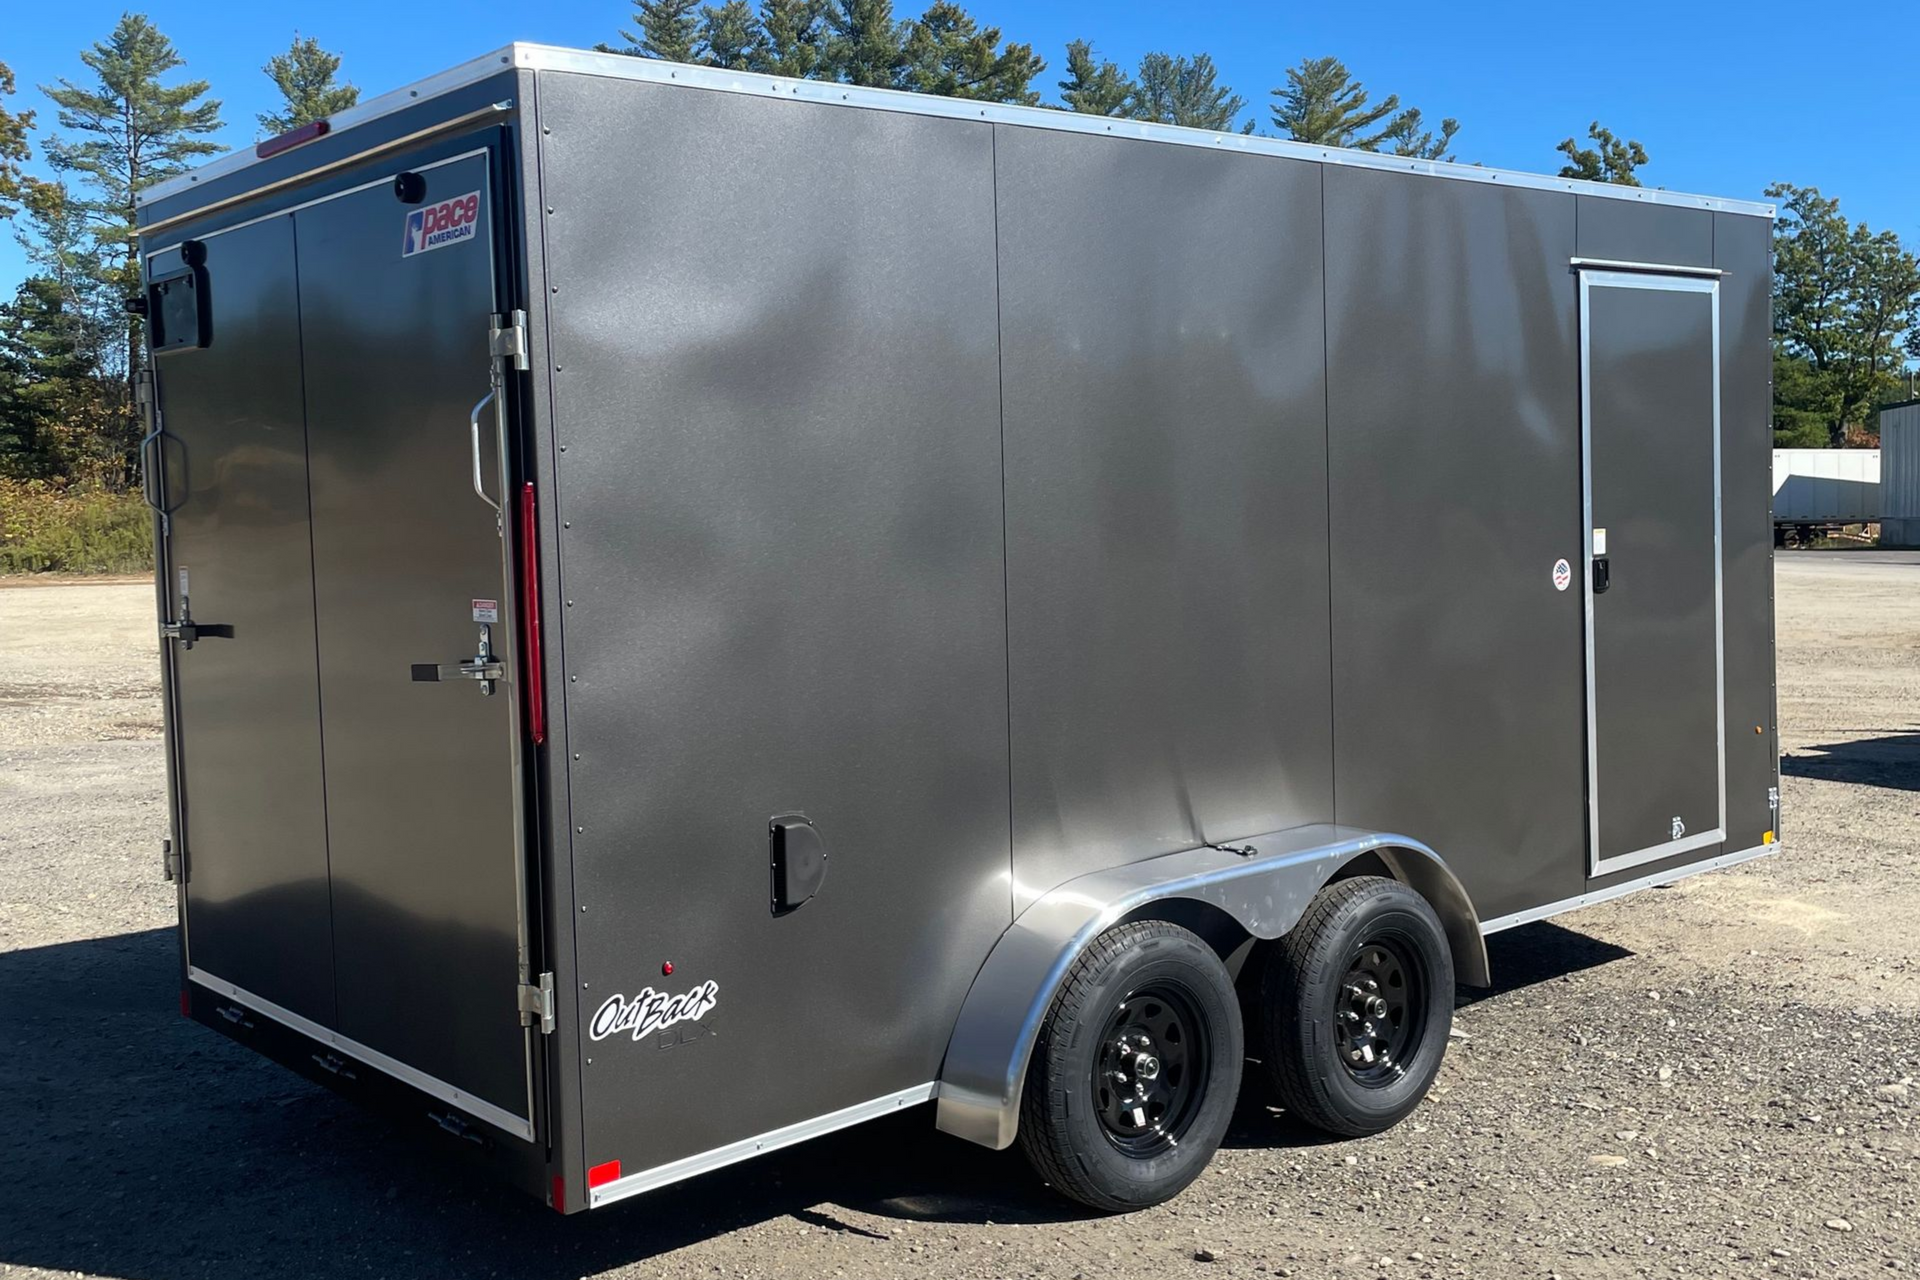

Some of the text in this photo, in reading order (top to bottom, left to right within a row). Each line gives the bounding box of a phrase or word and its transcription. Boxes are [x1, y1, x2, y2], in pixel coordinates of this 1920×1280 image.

[421, 194, 479, 250] pace
[428, 225, 472, 246] AMERICAN
[591, 981, 718, 1040] OutBack
